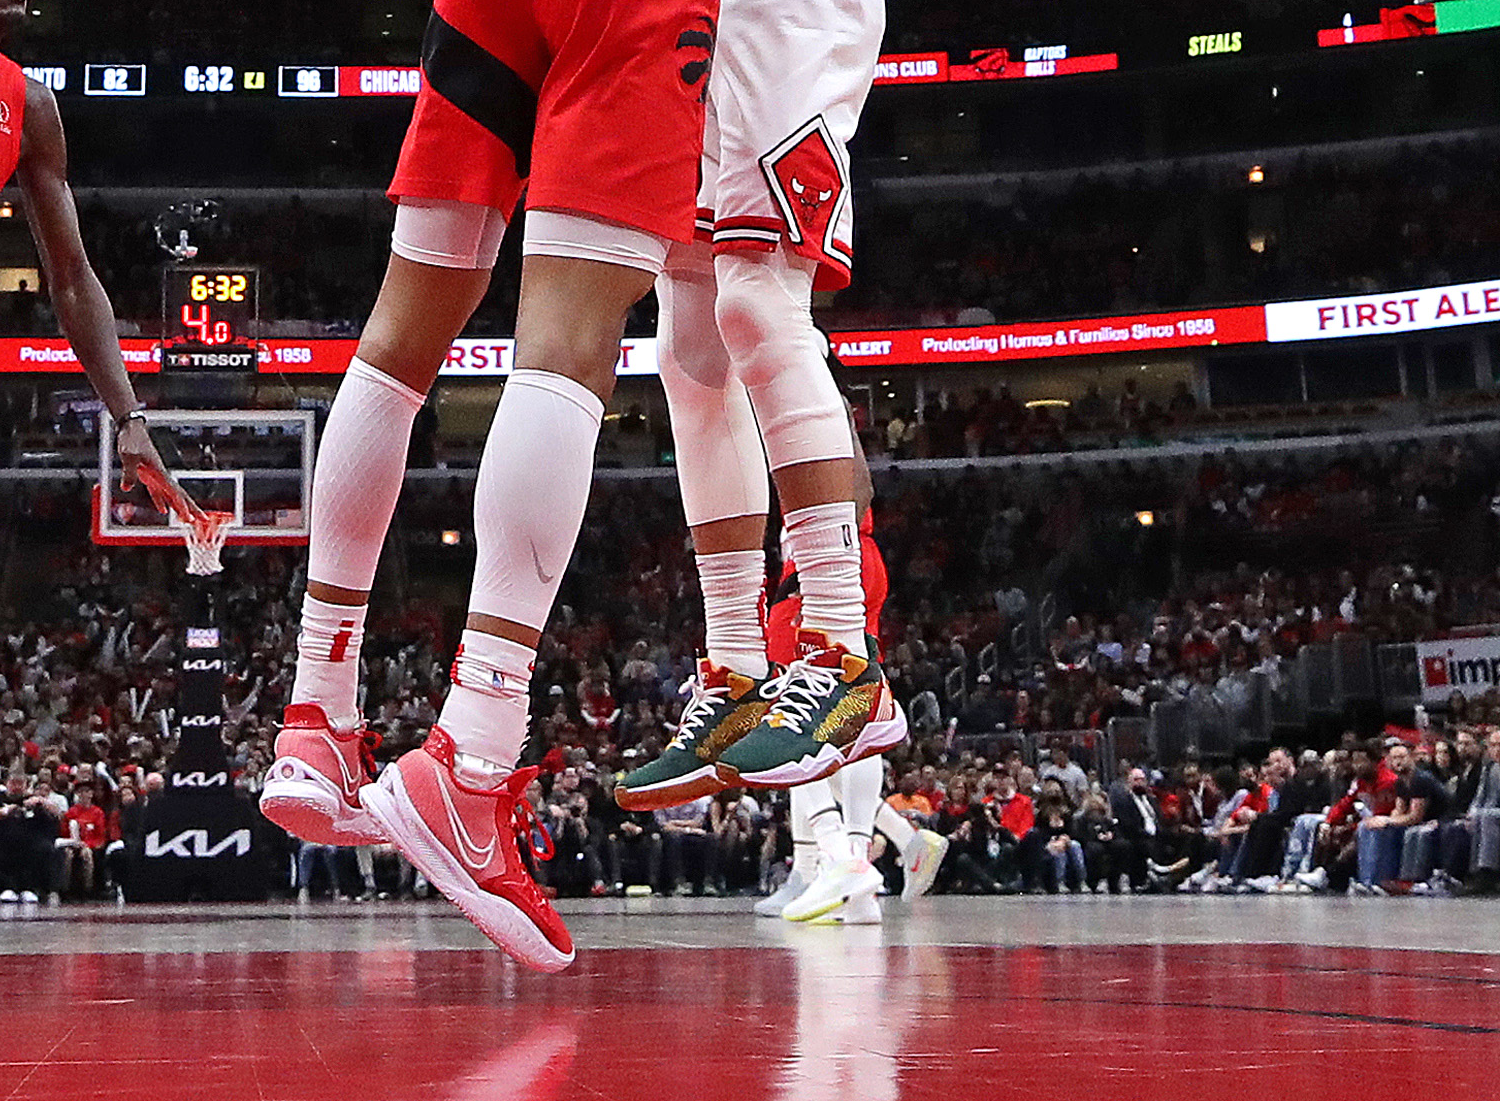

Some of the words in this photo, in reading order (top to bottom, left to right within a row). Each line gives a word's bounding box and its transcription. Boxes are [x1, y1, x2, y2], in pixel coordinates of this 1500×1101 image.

[1024, 44, 1067, 62] RAPTORS
[1187, 31, 1242, 57] STEALS
[102, 68, 129, 91] 82
[183, 66, 234, 92] 6:32
[898, 60, 939, 77] CLUB
[1024, 60, 1057, 77] BULLS
[296, 69, 322, 92] 96
[359, 69, 421, 94] CHICAG
[190, 274, 249, 302] 6:32
[180, 303, 232, 346] 4.0
[1316, 297, 1421, 332] FIRST
[921, 336, 999, 354] Protecting
[1000, 332, 1054, 350] Homes
[1055, 330, 1068, 345] &
[1069, 326, 1130, 343] Families
[1131, 321, 1175, 341] Since
[1175, 317, 1215, 336] 1958
[190, 353, 252, 367] TISSOT
[274, 347, 312, 363] 1958
[838, 340, 892, 357] ALERT
